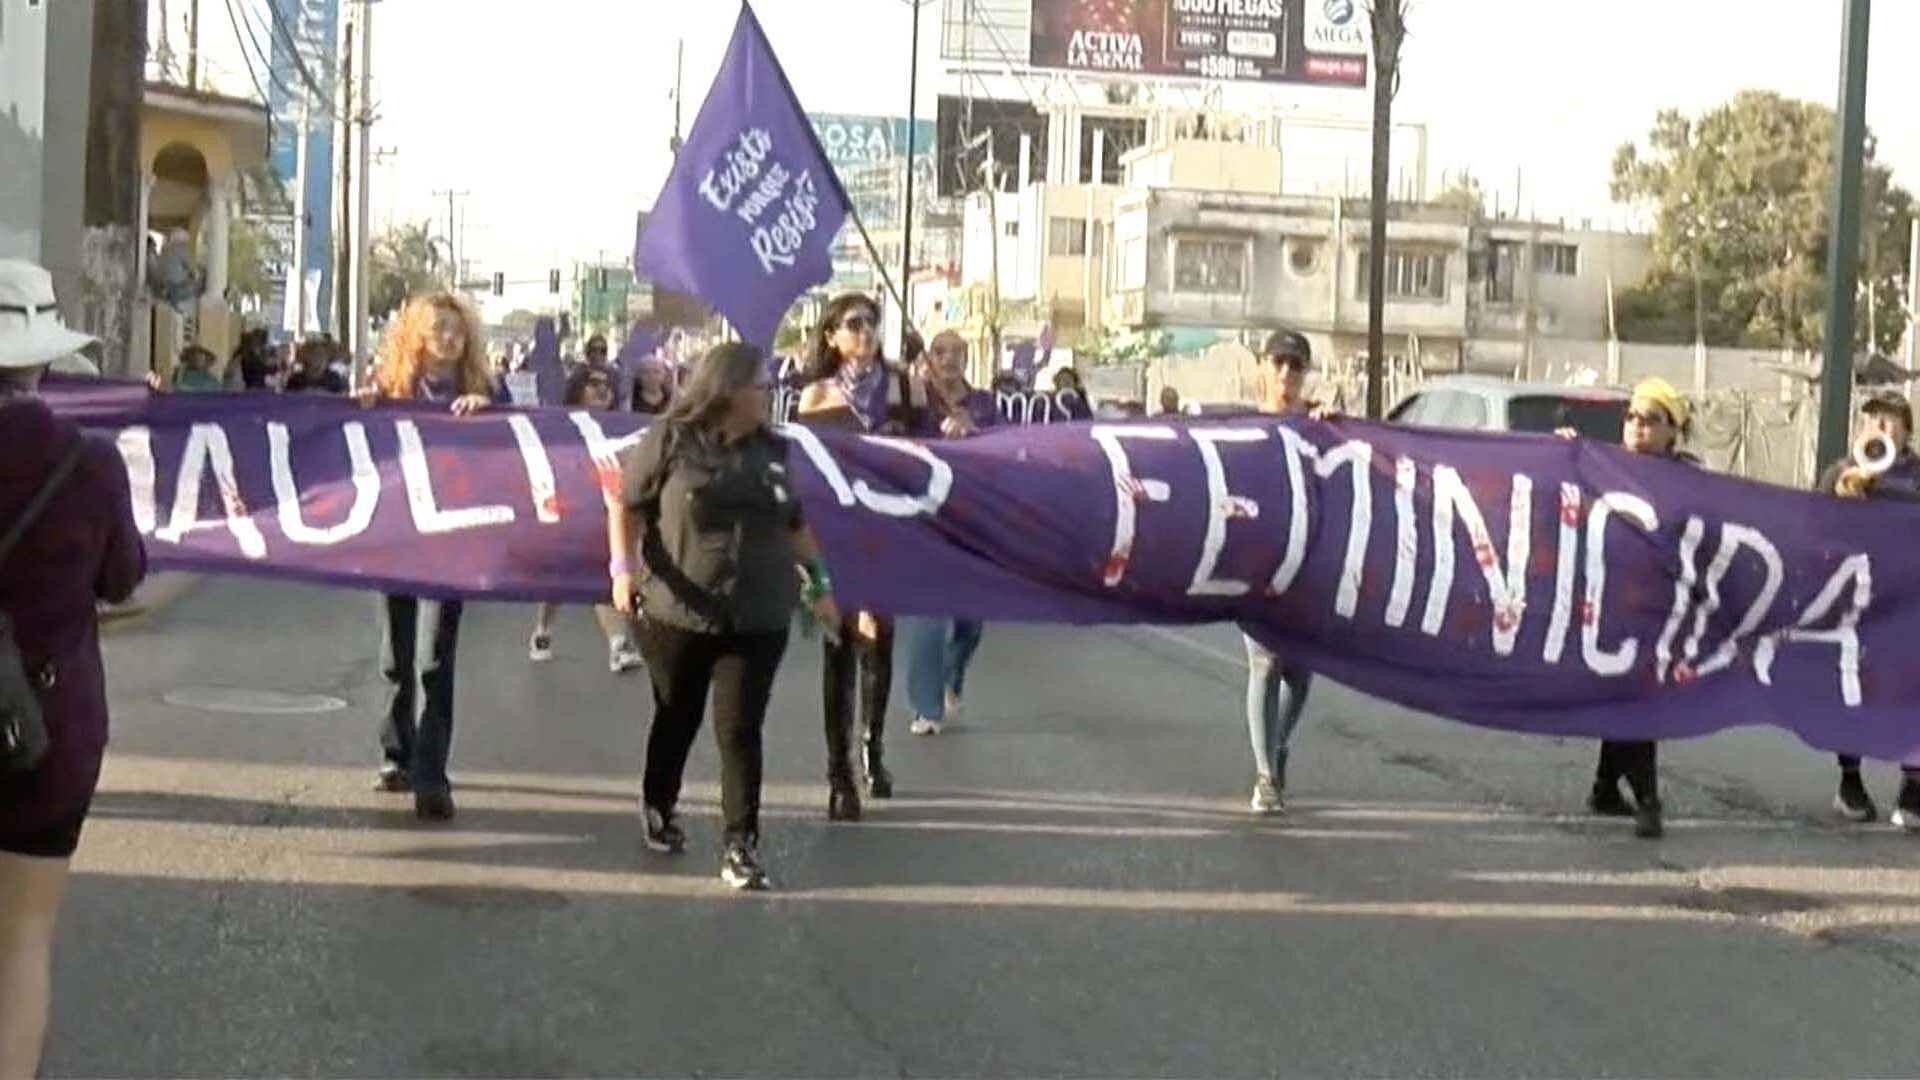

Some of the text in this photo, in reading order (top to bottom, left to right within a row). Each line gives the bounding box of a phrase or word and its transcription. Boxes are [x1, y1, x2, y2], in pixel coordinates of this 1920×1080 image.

[1218, 0, 1282, 18] MEGAS
[1068, 30, 1142, 54] ACTIVA
[1313, 25, 1364, 43] MEGA
[1068, 49, 1088, 65] LA
[1090, 426, 1872, 706] FEMINICIDA
